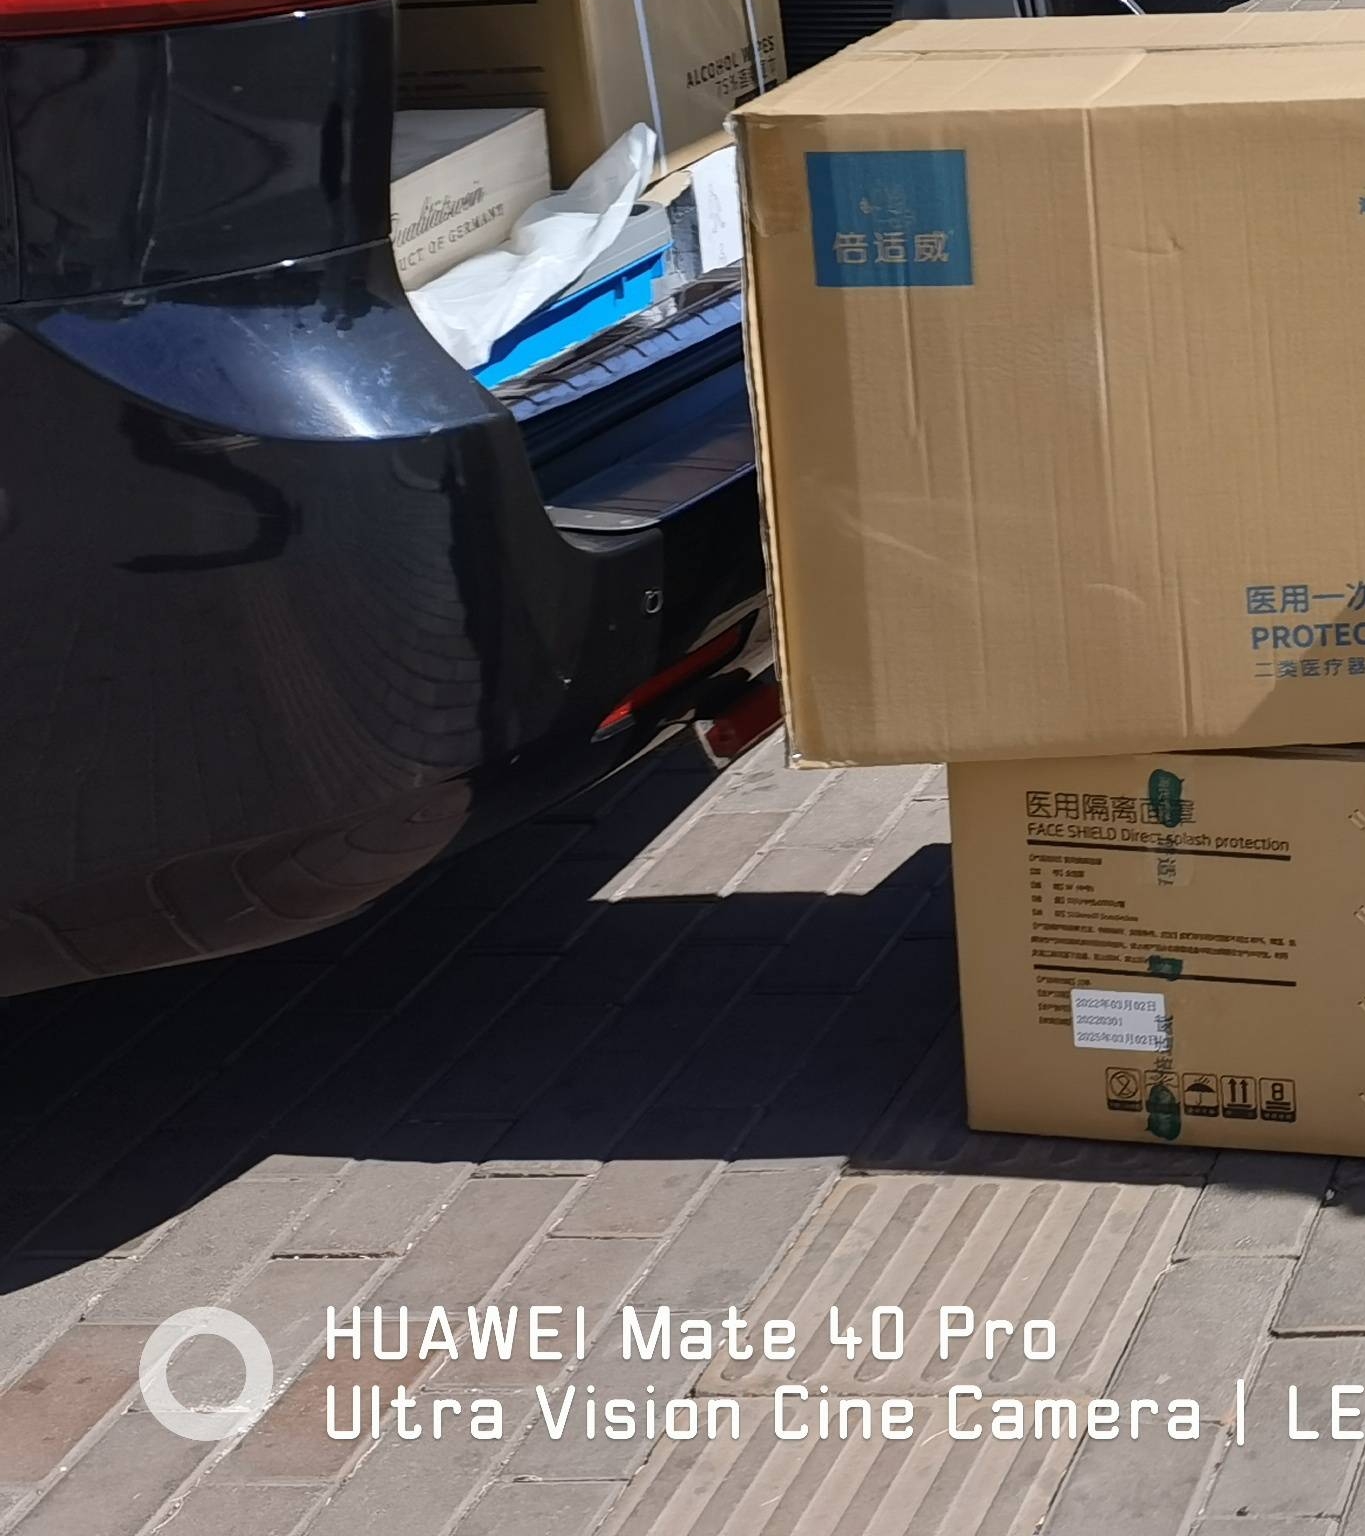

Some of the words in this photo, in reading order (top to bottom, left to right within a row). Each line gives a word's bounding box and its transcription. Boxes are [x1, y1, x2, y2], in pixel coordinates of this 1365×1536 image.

[832, 230, 951, 264] 倍适威
[1027, 823, 1064, 838] FACE
[1067, 826, 1117, 841] SHIELD
[1215, 836, 1290, 853] protection
